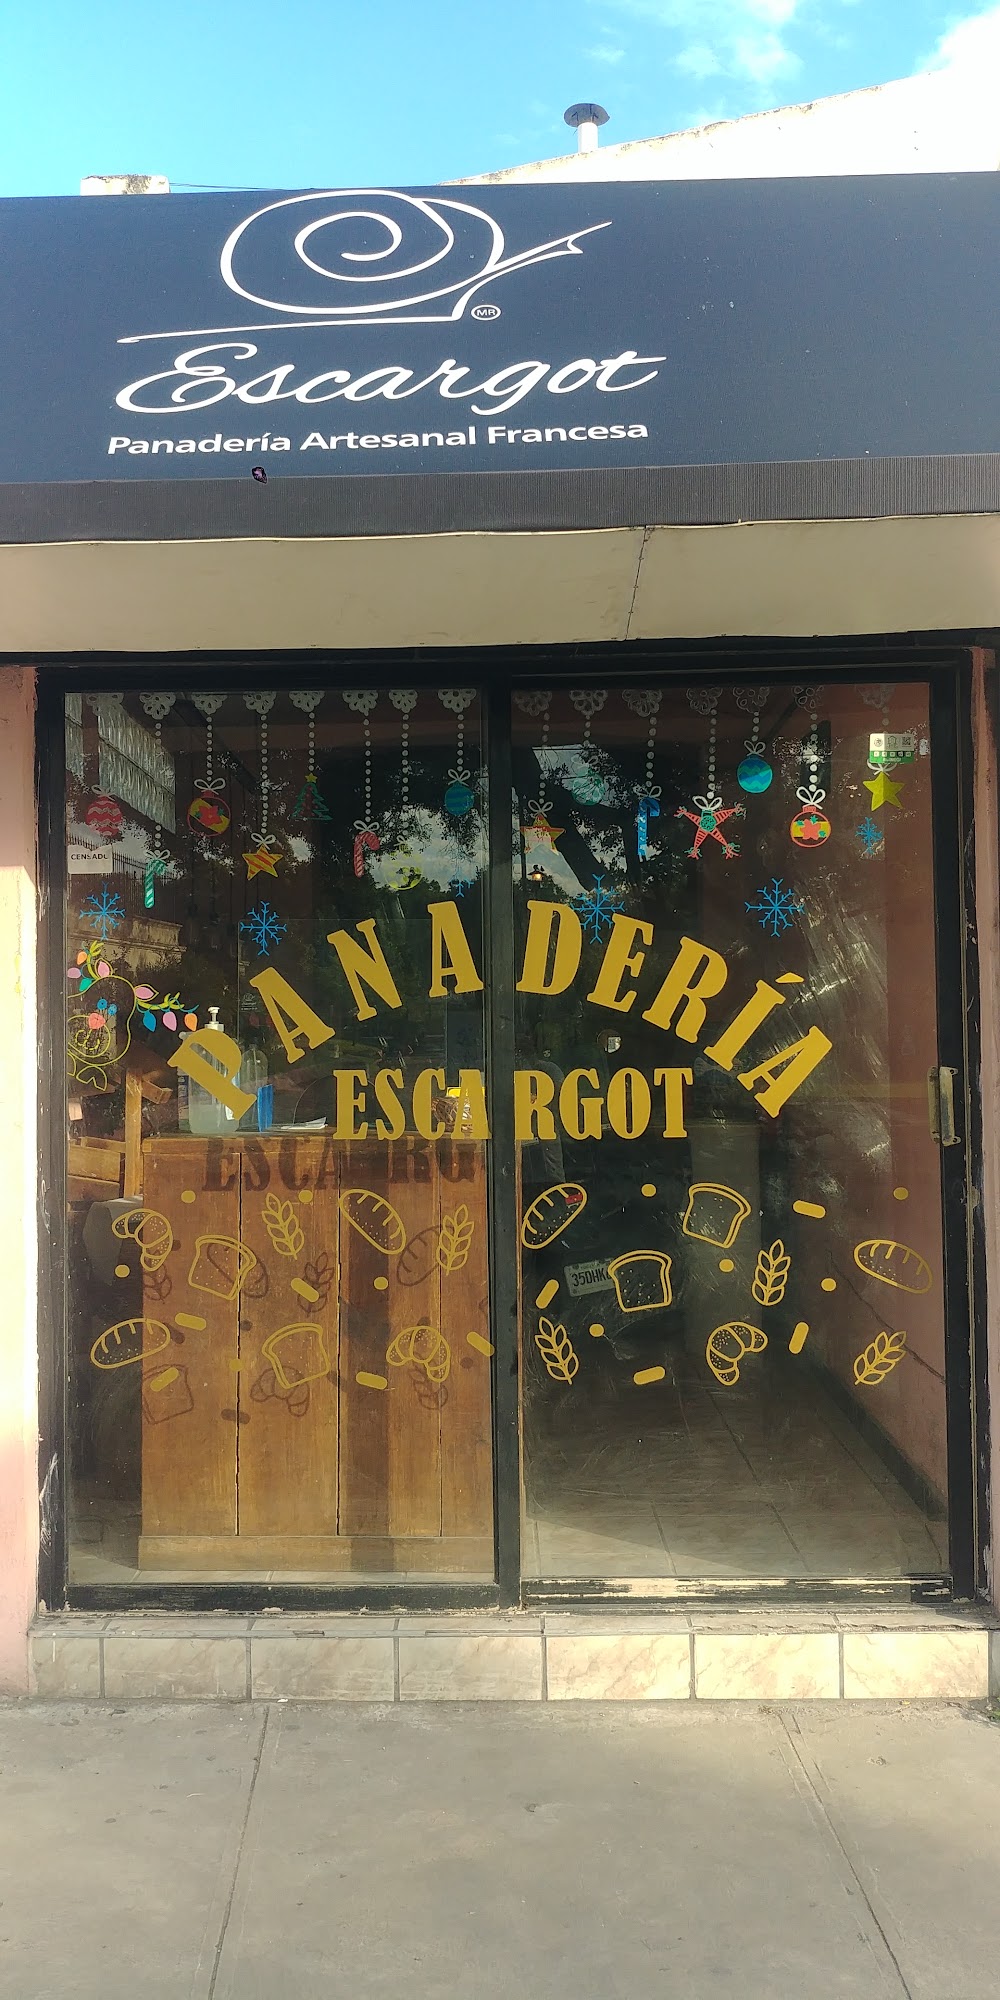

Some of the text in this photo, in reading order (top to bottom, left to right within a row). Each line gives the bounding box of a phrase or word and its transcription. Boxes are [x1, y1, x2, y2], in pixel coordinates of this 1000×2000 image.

[116, 342, 667, 416] Escargot
[107, 423, 649, 455] Panadería Artesanal Francesa
[167, 899, 833, 1120] PANADERÍA
[333, 1067, 694, 1141] ESCARGOT
